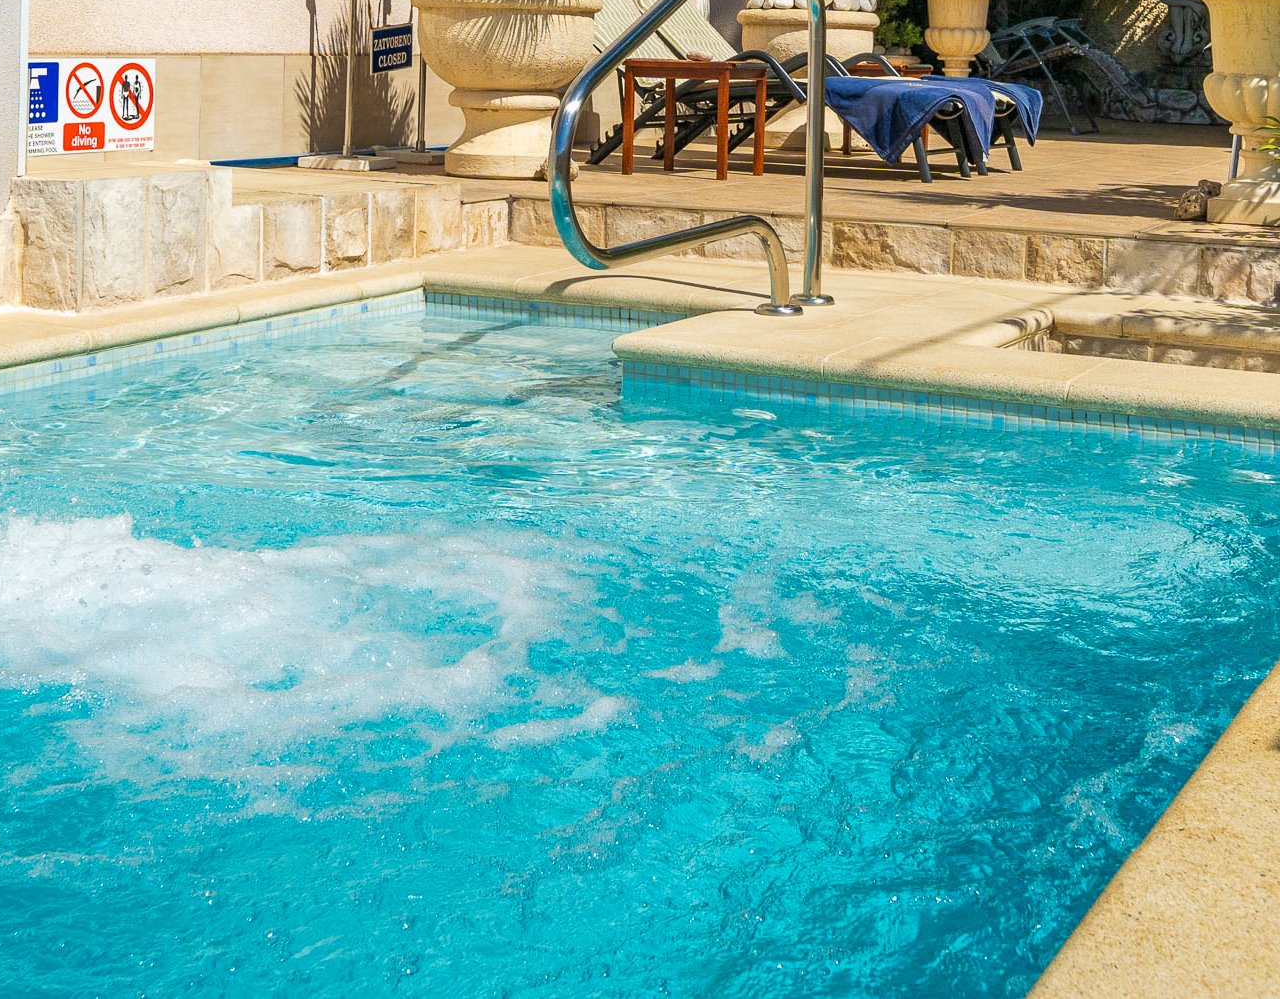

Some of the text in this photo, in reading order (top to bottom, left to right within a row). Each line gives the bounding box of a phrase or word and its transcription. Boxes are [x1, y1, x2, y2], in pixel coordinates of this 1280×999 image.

[374, 34, 412, 51] ZATVORENO
[378, 51, 407, 68] CLOSED
[78, 124, 91, 134] No
[32, 139, 55, 147] ENTERING
[71, 135, 98, 148] diving
